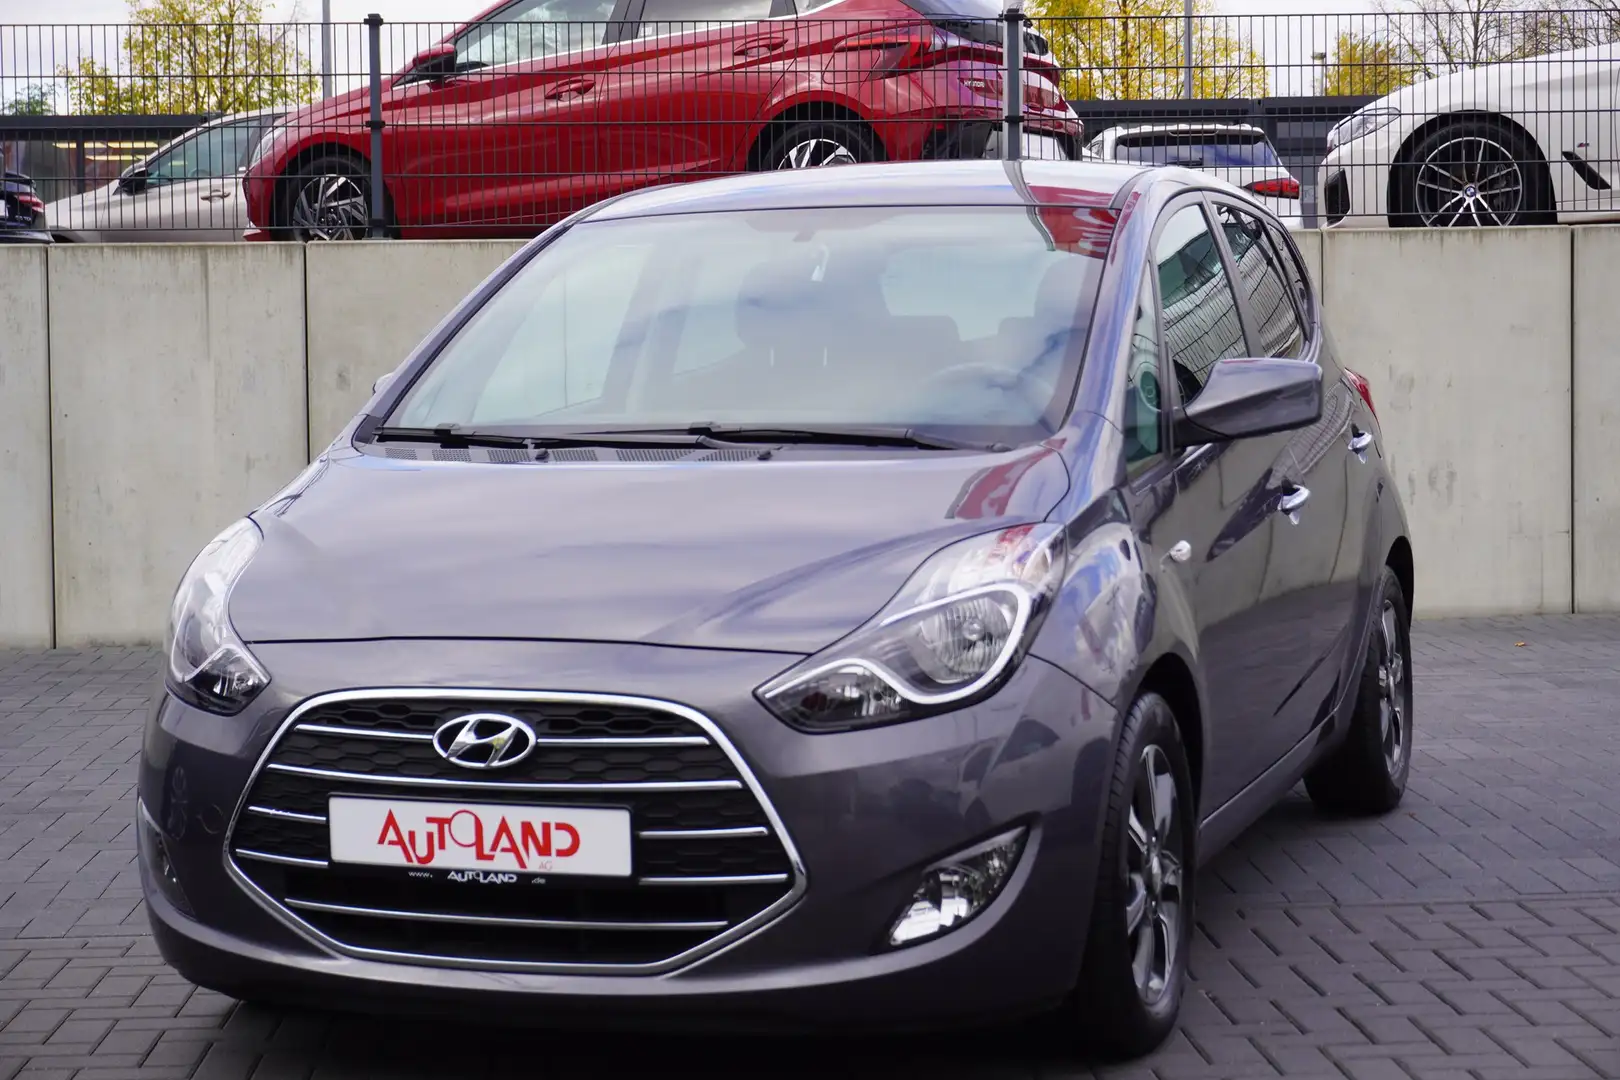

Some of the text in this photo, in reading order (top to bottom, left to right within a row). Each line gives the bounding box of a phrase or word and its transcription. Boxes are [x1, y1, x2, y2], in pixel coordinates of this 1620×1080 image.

[377, 808, 581, 870] AUTOLAND
[408, 870, 434, 878] www.
[447, 870, 518, 884] AUTOLAND
